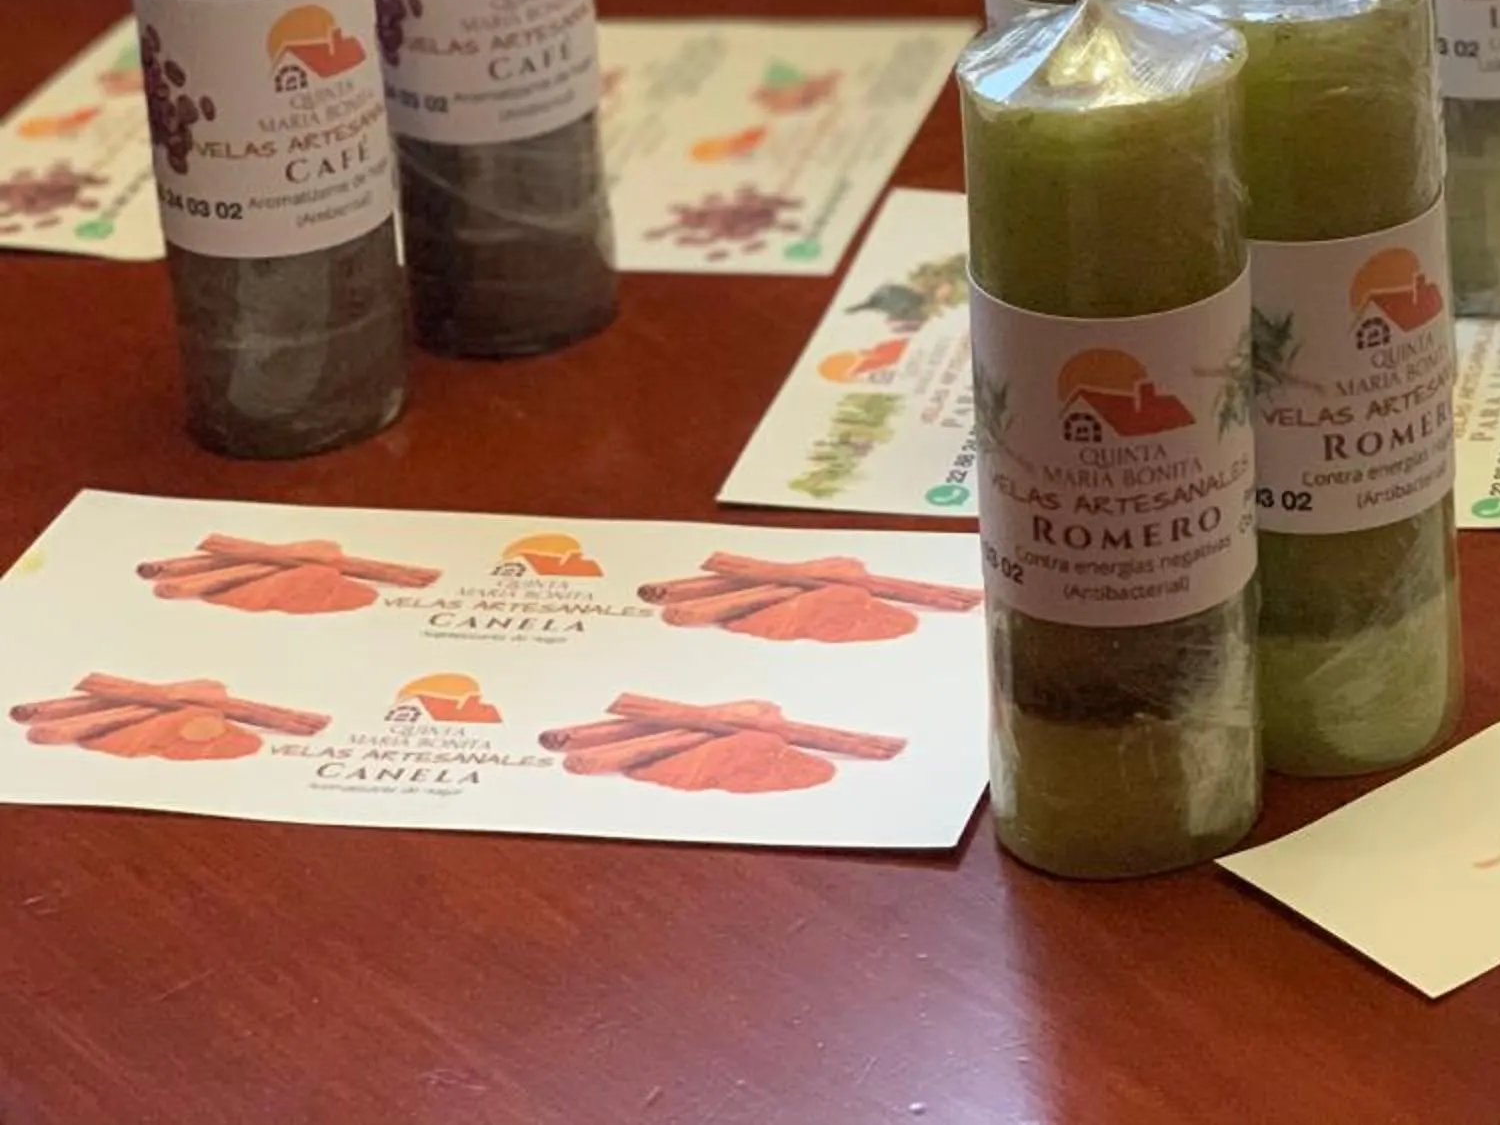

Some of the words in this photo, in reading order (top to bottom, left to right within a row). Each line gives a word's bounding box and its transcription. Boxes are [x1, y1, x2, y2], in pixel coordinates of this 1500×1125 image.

[1453, 40, 1480, 58] 02
[194, 139, 277, 159] VELAS
[187, 199, 211, 218] 03
[215, 202, 244, 221] 02
[1261, 406, 1355, 427] VELAS
[1078, 443, 1168, 470] QUINTA
[1041, 463, 1115, 489] MARIA
[1121, 457, 1204, 487] BONITA
[1073, 452, 1250, 516] ARTESANALES
[1281, 489, 1313, 512] 02
[1302, 468, 1364, 489] Contra
[1031, 505, 1223, 551] ROMERO
[1001, 556, 1025, 586] 02
[1015, 544, 1070, 574] Contra
[383, 596, 464, 610] VELAS
[473, 600, 655, 618] ARTESANALES
[427, 611, 587, 633] CANELA
[269, 743, 354, 761] VELAS
[361, 748, 556, 769] ARTESANALES
[315, 762, 481, 786] CANELA
